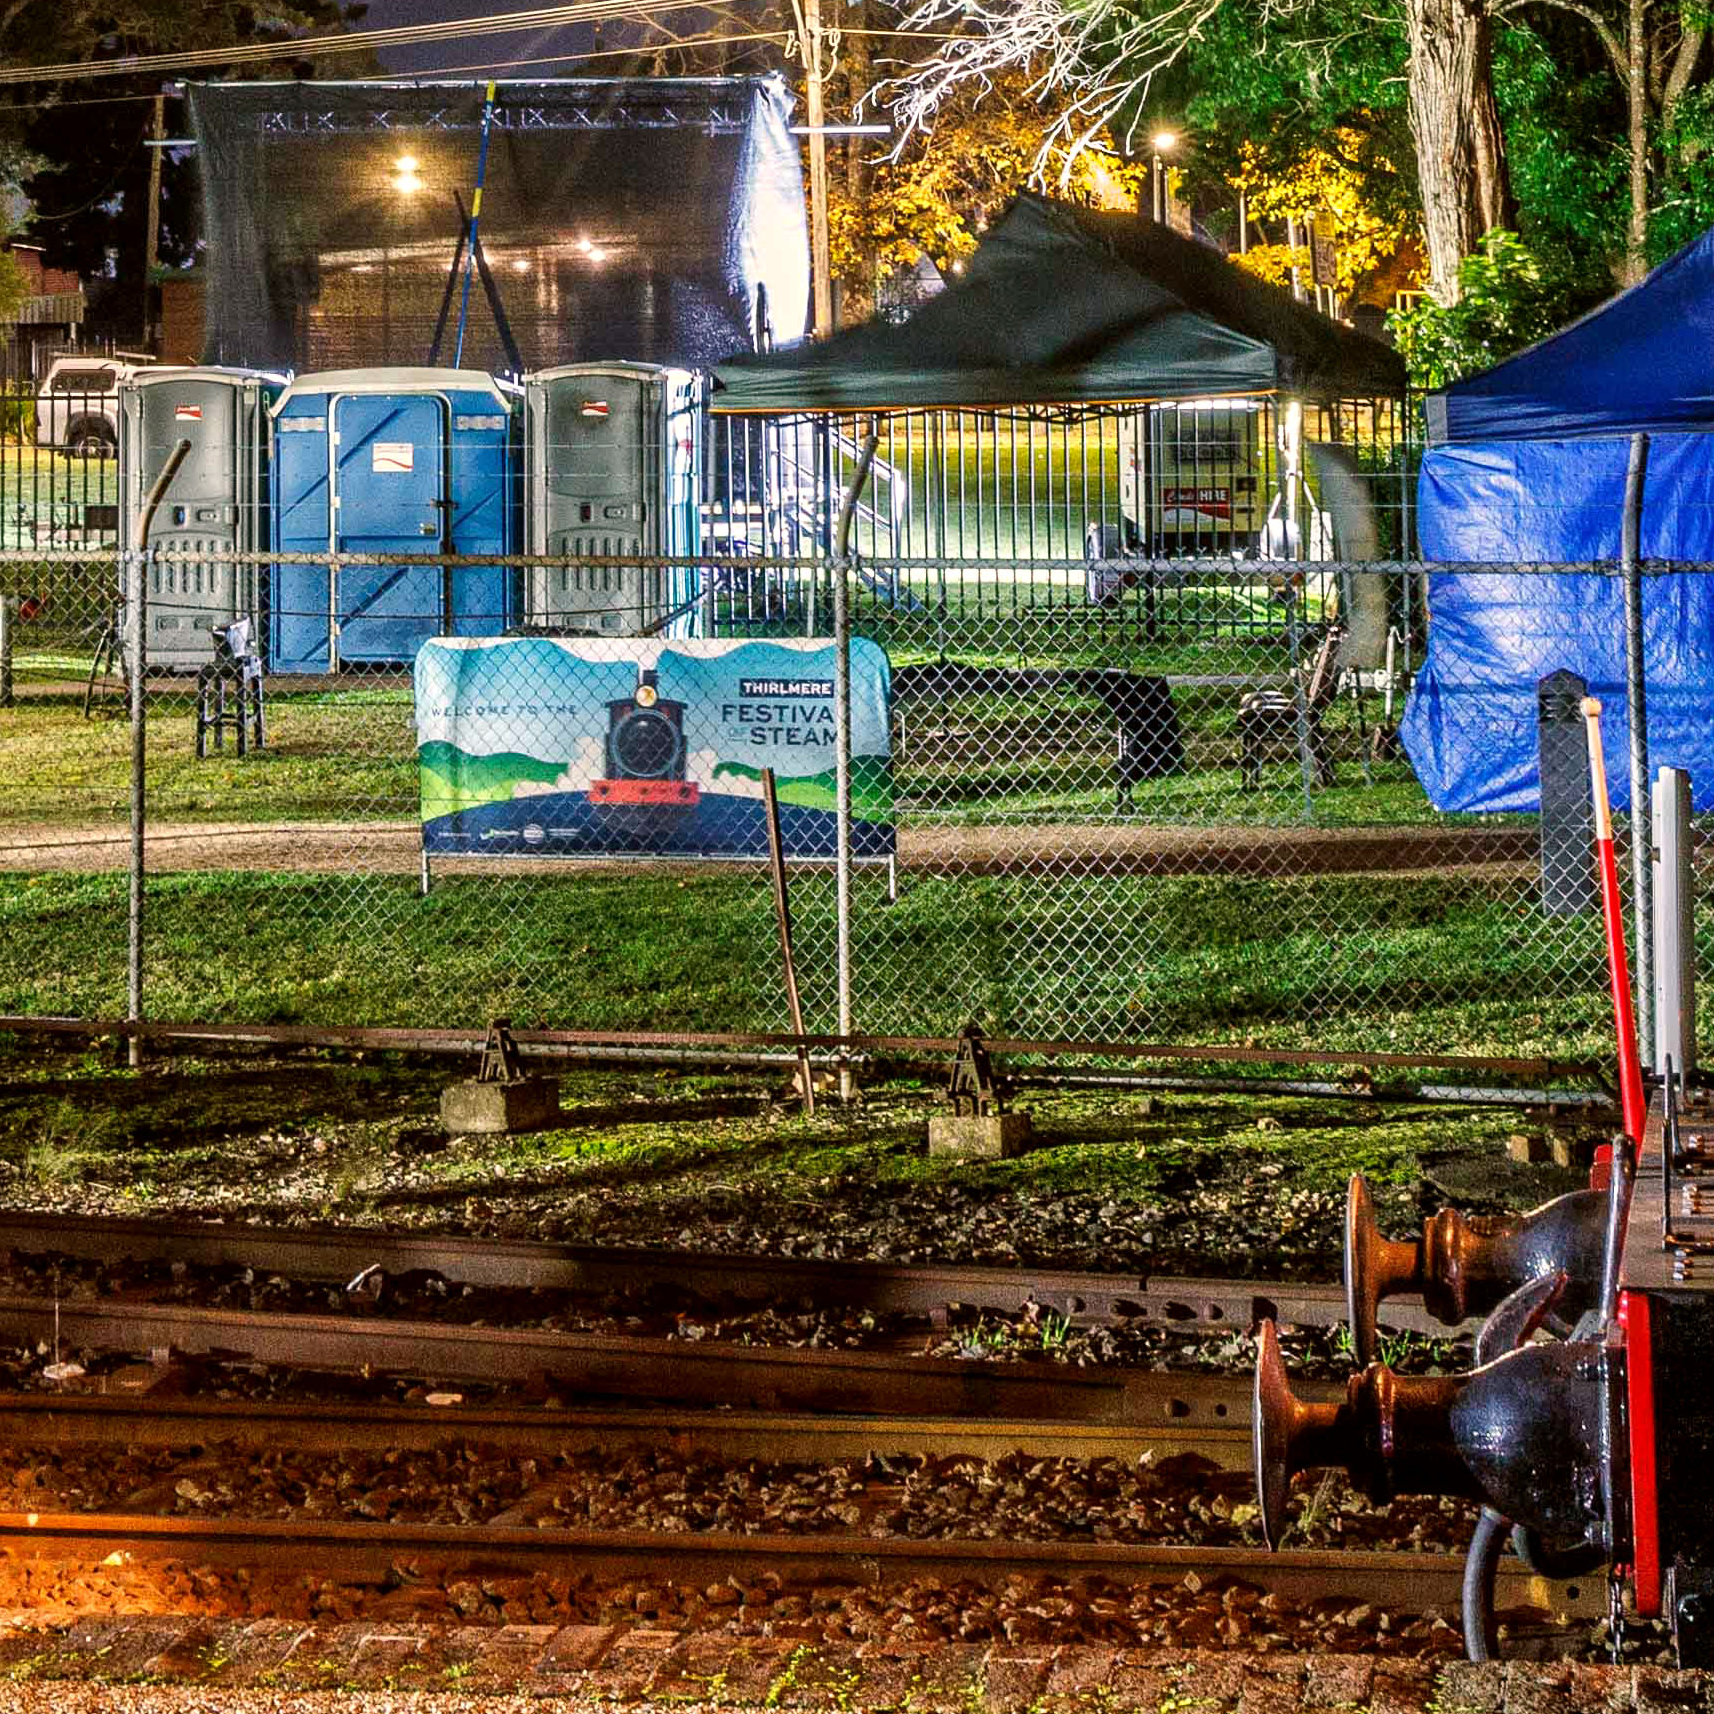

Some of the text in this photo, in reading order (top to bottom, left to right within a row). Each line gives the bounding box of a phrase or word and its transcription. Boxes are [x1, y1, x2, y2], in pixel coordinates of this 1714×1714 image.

[743, 682, 831, 694] THIRLMERE
[431, 705, 510, 717] WELCOME
[722, 704, 834, 723] FESTIVA
[750, 726, 838, 746] STEAM
